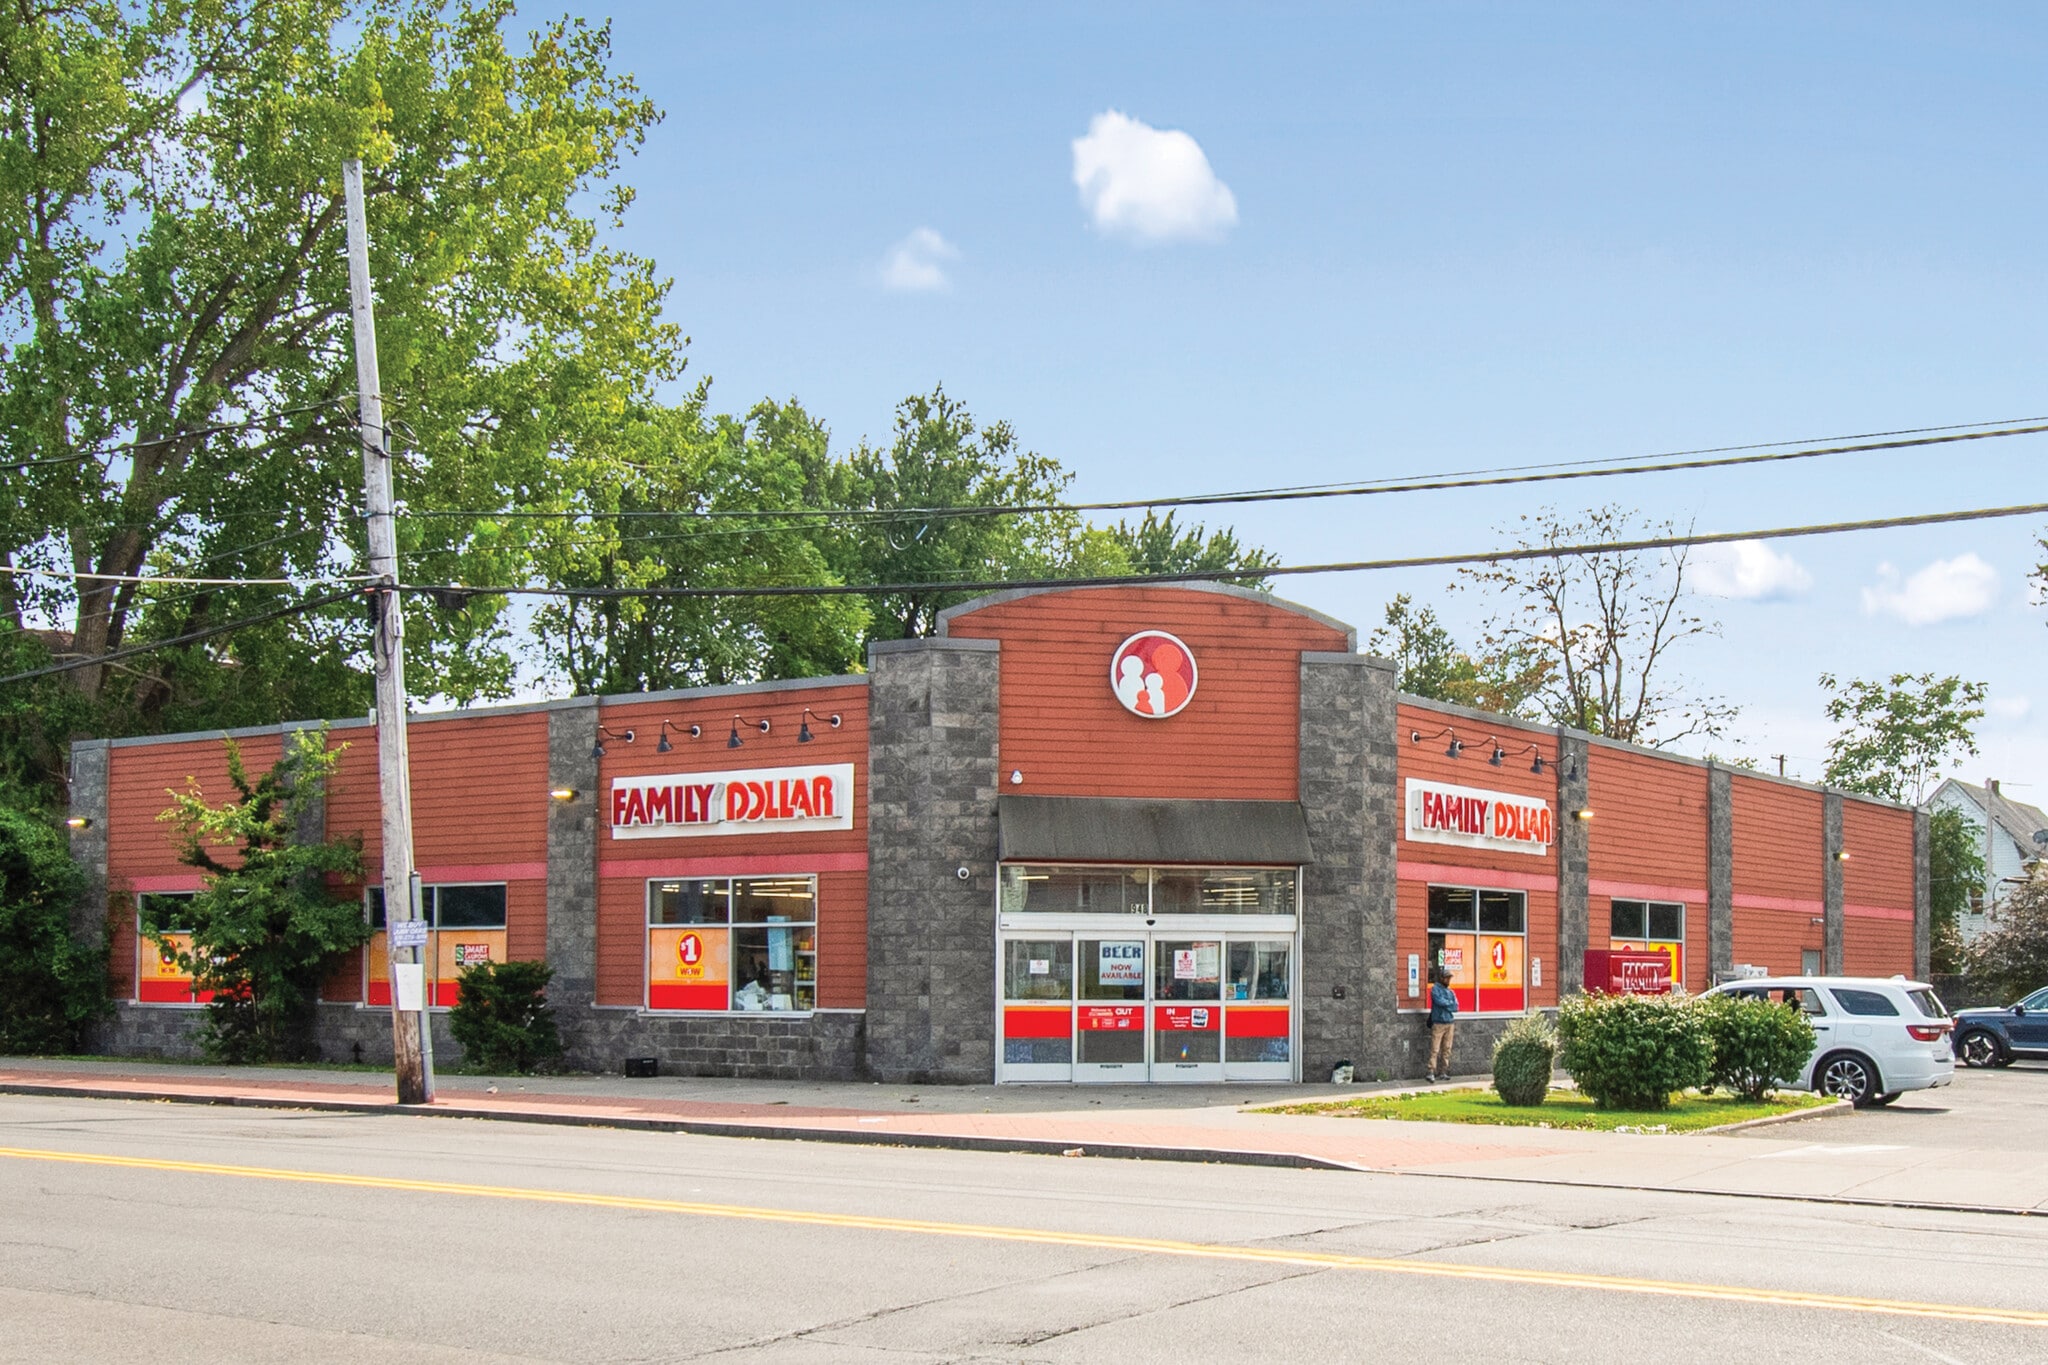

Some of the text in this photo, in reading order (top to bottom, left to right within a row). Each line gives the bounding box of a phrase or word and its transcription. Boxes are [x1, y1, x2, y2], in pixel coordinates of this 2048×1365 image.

[612, 775, 834, 826] FAMILY DOLLAR
[1423, 791, 1551, 844] FAMILY DOLLAR
[464, 945, 488, 953] SMART
[680, 936, 697, 961] $1
[1102, 946, 1141, 959] BEER
[1111, 963, 1132, 971] NOW
[1101, 971, 1142, 979] AVAILABLE
[1115, 1008, 1133, 1016] OUT
